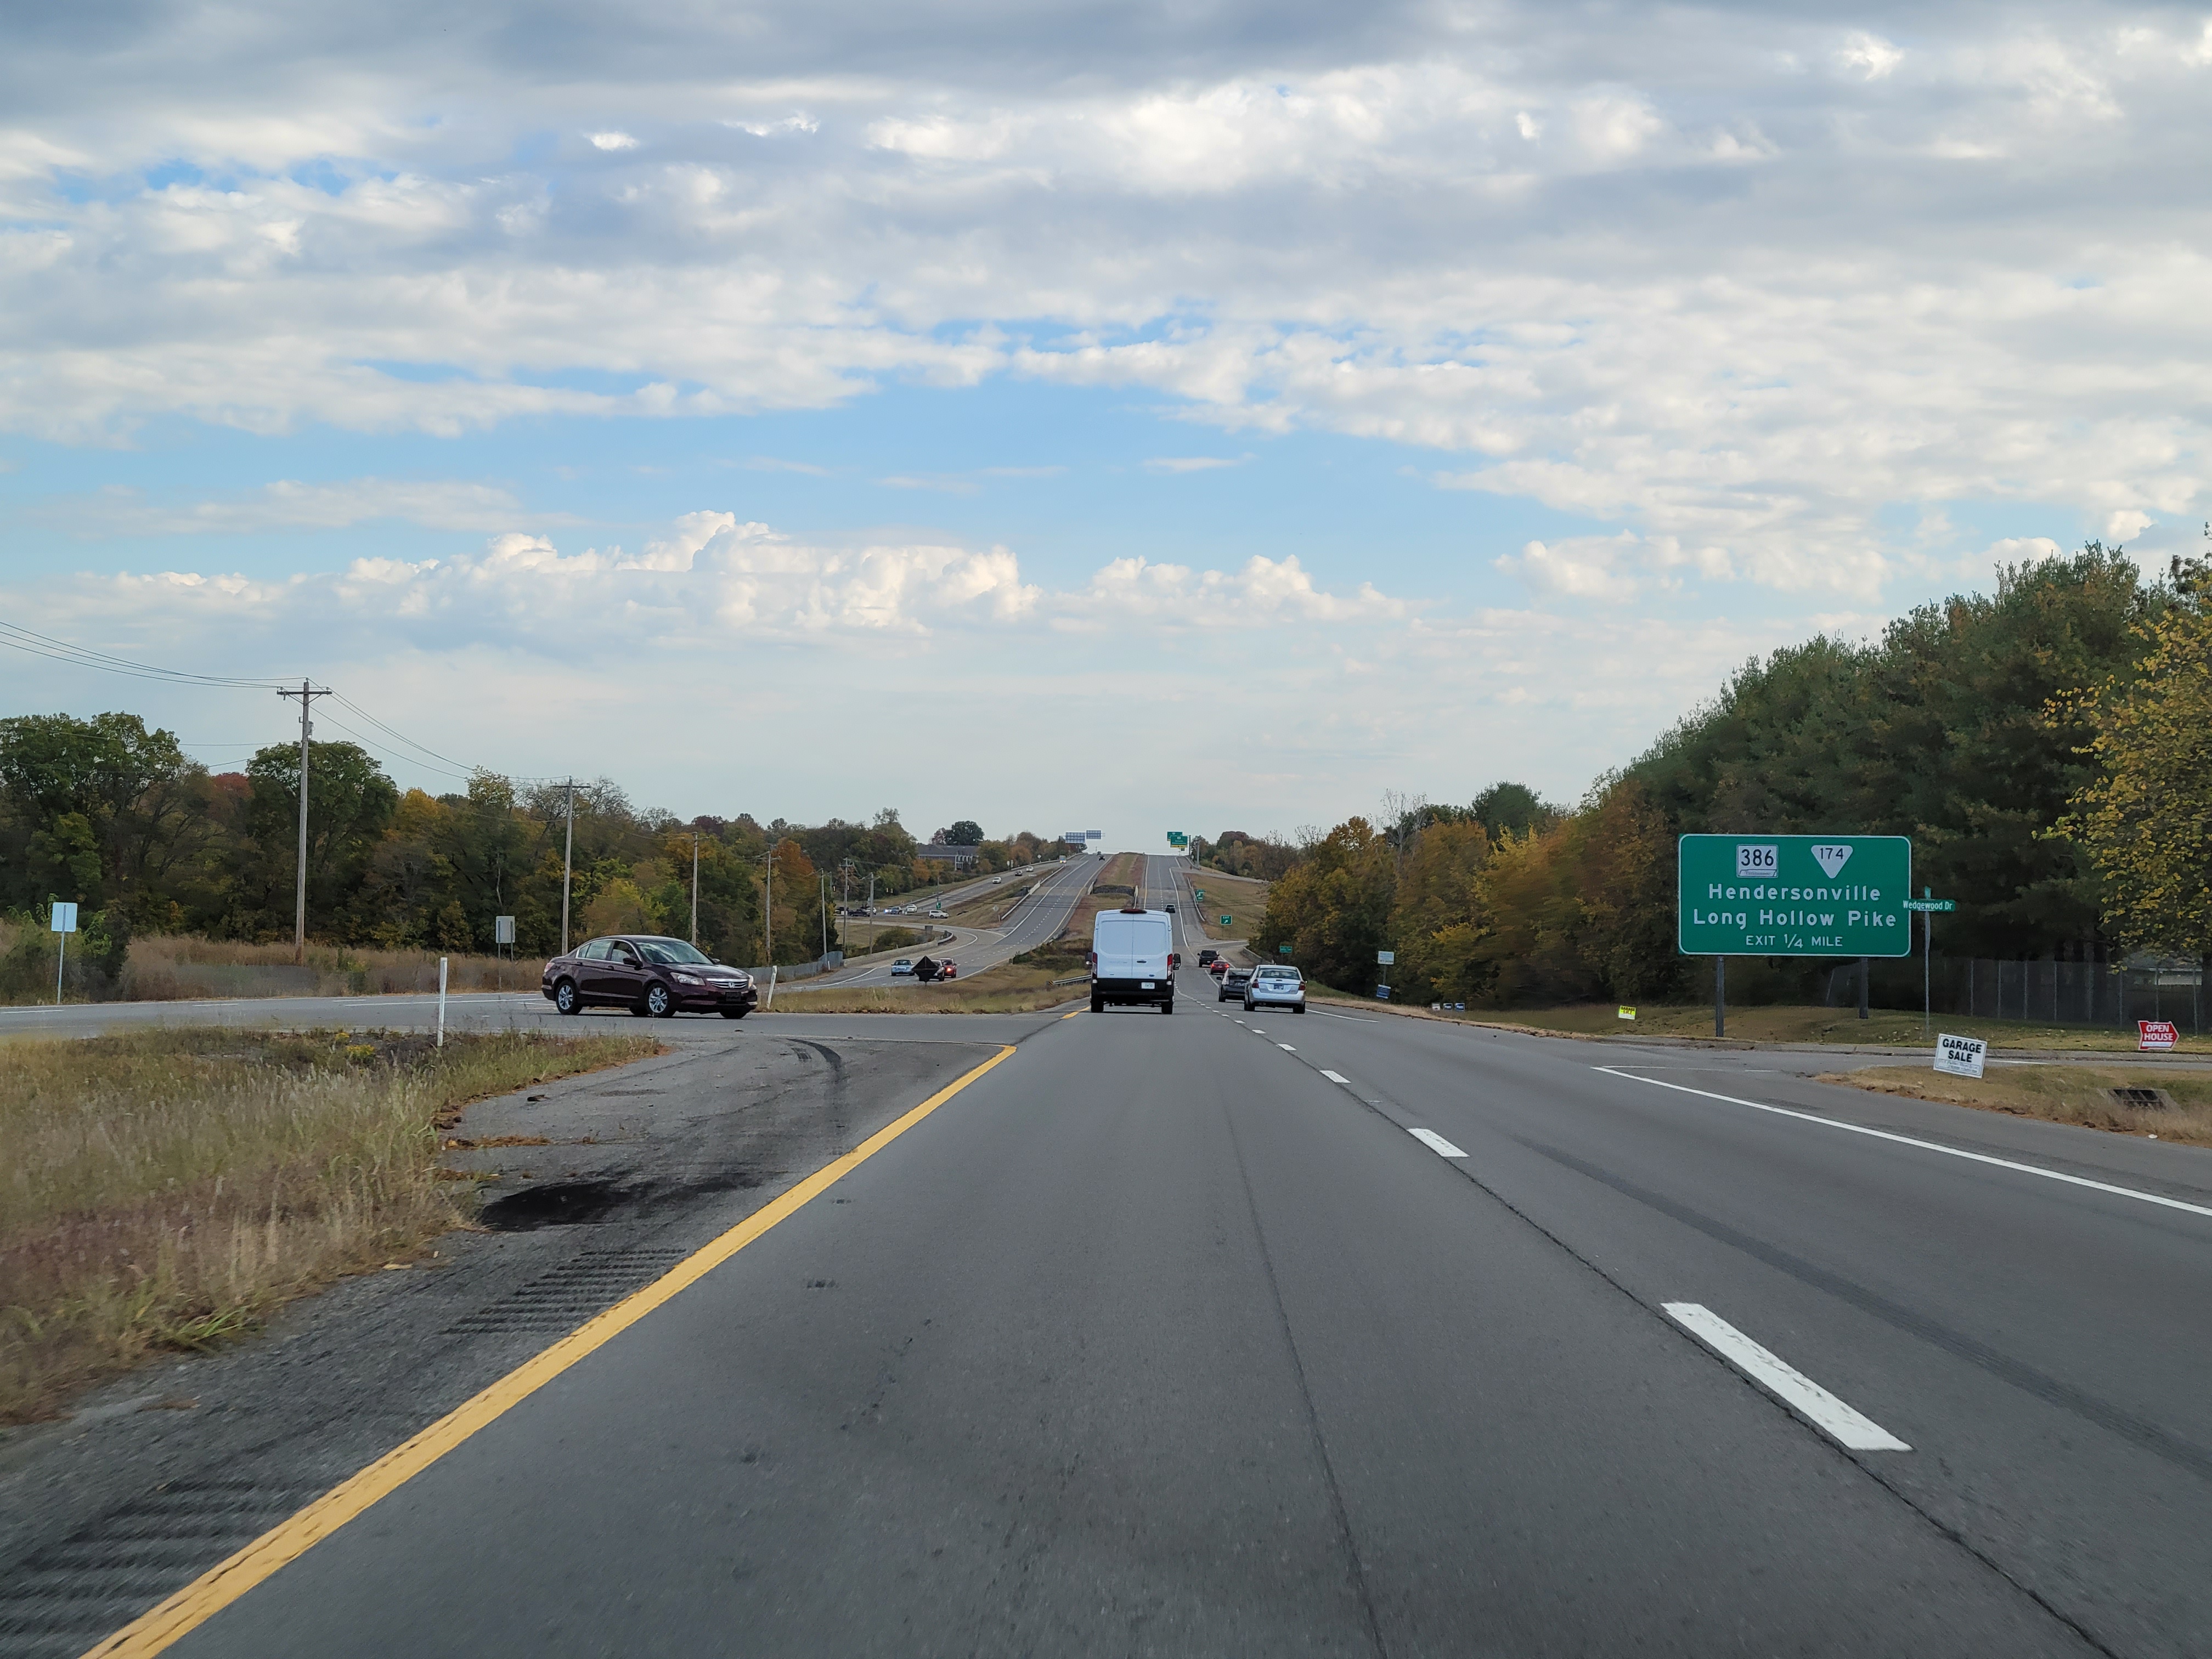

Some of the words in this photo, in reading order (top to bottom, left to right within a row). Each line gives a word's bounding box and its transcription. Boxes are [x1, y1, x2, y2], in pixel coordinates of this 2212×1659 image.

[1741, 849, 1774, 867] 386
[1819, 848, 1844, 860] 174
[1709, 883, 1881, 901] Hendersonville
[1903, 900, 1943, 911] Wedgewood
[1945, 901, 1953, 910] Dr
[1694, 909, 1747, 930] Long
[1759, 909, 1835, 926] Hollow
[1848, 910, 1897, 927] Pike
[1746, 935, 1776, 946] EXIT
[1811, 936, 1843, 947] MILE
[2146, 1024, 2170, 1032] OPEN
[2144, 1032, 2174, 1041] HOUSE
[1942, 1038, 1983, 1054] GARAGE
[1948, 1050, 1973, 1063] SALE
